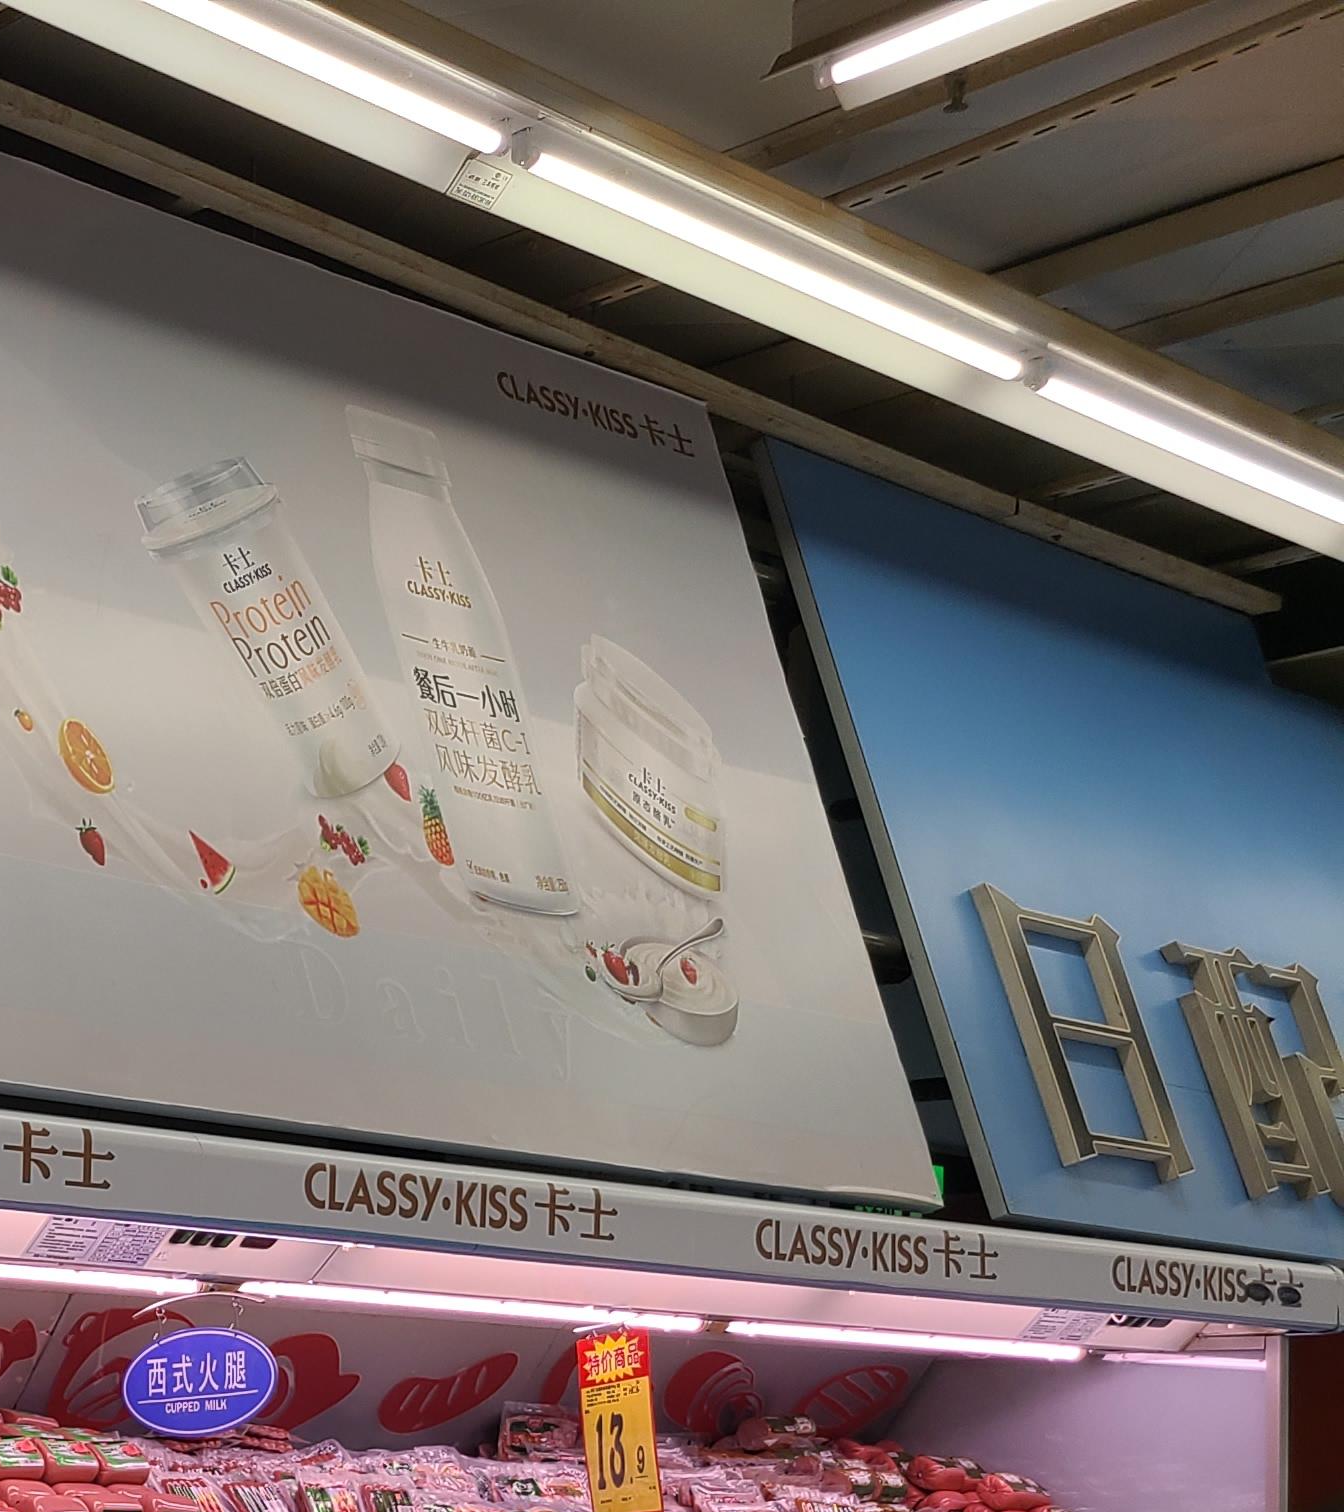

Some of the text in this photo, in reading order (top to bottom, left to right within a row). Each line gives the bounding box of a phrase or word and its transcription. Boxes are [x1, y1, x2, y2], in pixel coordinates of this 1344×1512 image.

[640, 413, 696, 458] 卡士
[209, 574, 312, 640] Protein
[231, 614, 331, 679] Protein
[412, 665, 521, 723] 餐后一小时
[3, 1121, 116, 1190] 卡士
[534, 1181, 619, 1241] 卡士
[933, 1229, 1000, 1281] 卡士
[145, 1349, 248, 1399] 西式火腿
[588, 1342, 641, 1378] 特价商品
[164, 1397, 229, 1415] CUPPED MILK
